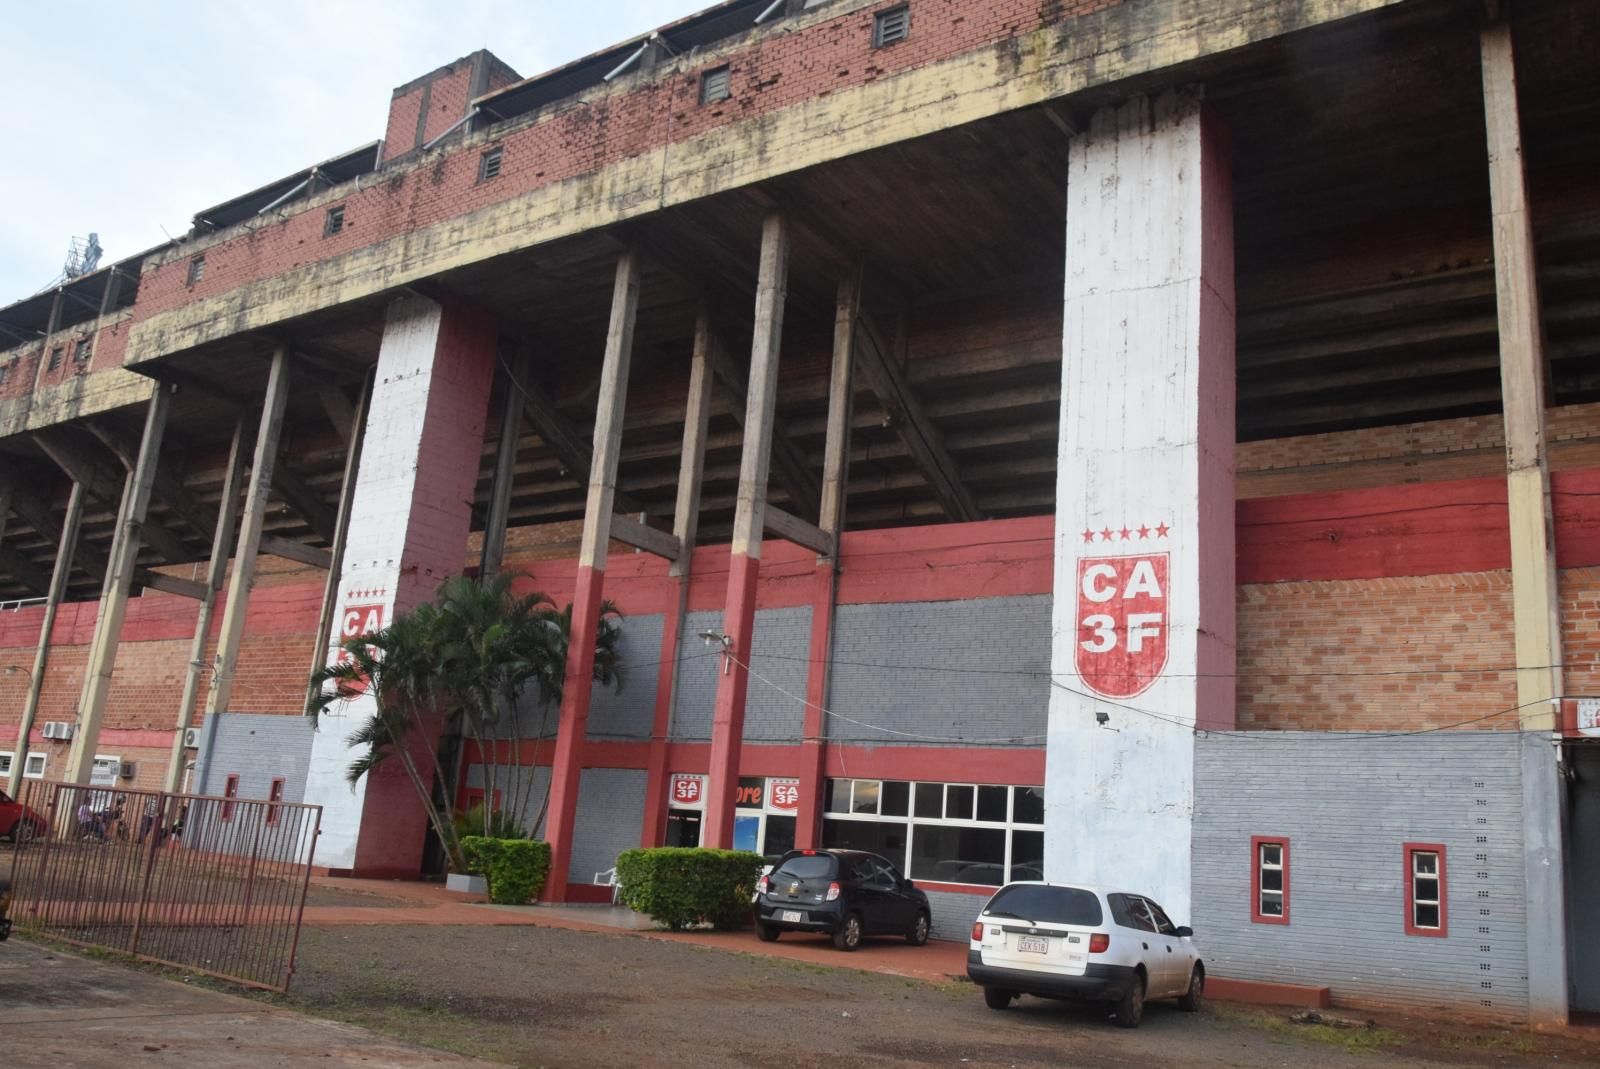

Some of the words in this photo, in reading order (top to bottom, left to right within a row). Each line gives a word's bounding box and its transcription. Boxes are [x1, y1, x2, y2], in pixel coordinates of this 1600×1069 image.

[1082, 560, 1162, 603] CA
[343, 609, 379, 637] CA
[1080, 612, 1163, 653] 3F
[677, 780, 698, 790] CA
[775, 785, 798, 796] CA
[676, 789, 698, 799] 3F
[775, 794, 799, 804] 3F
